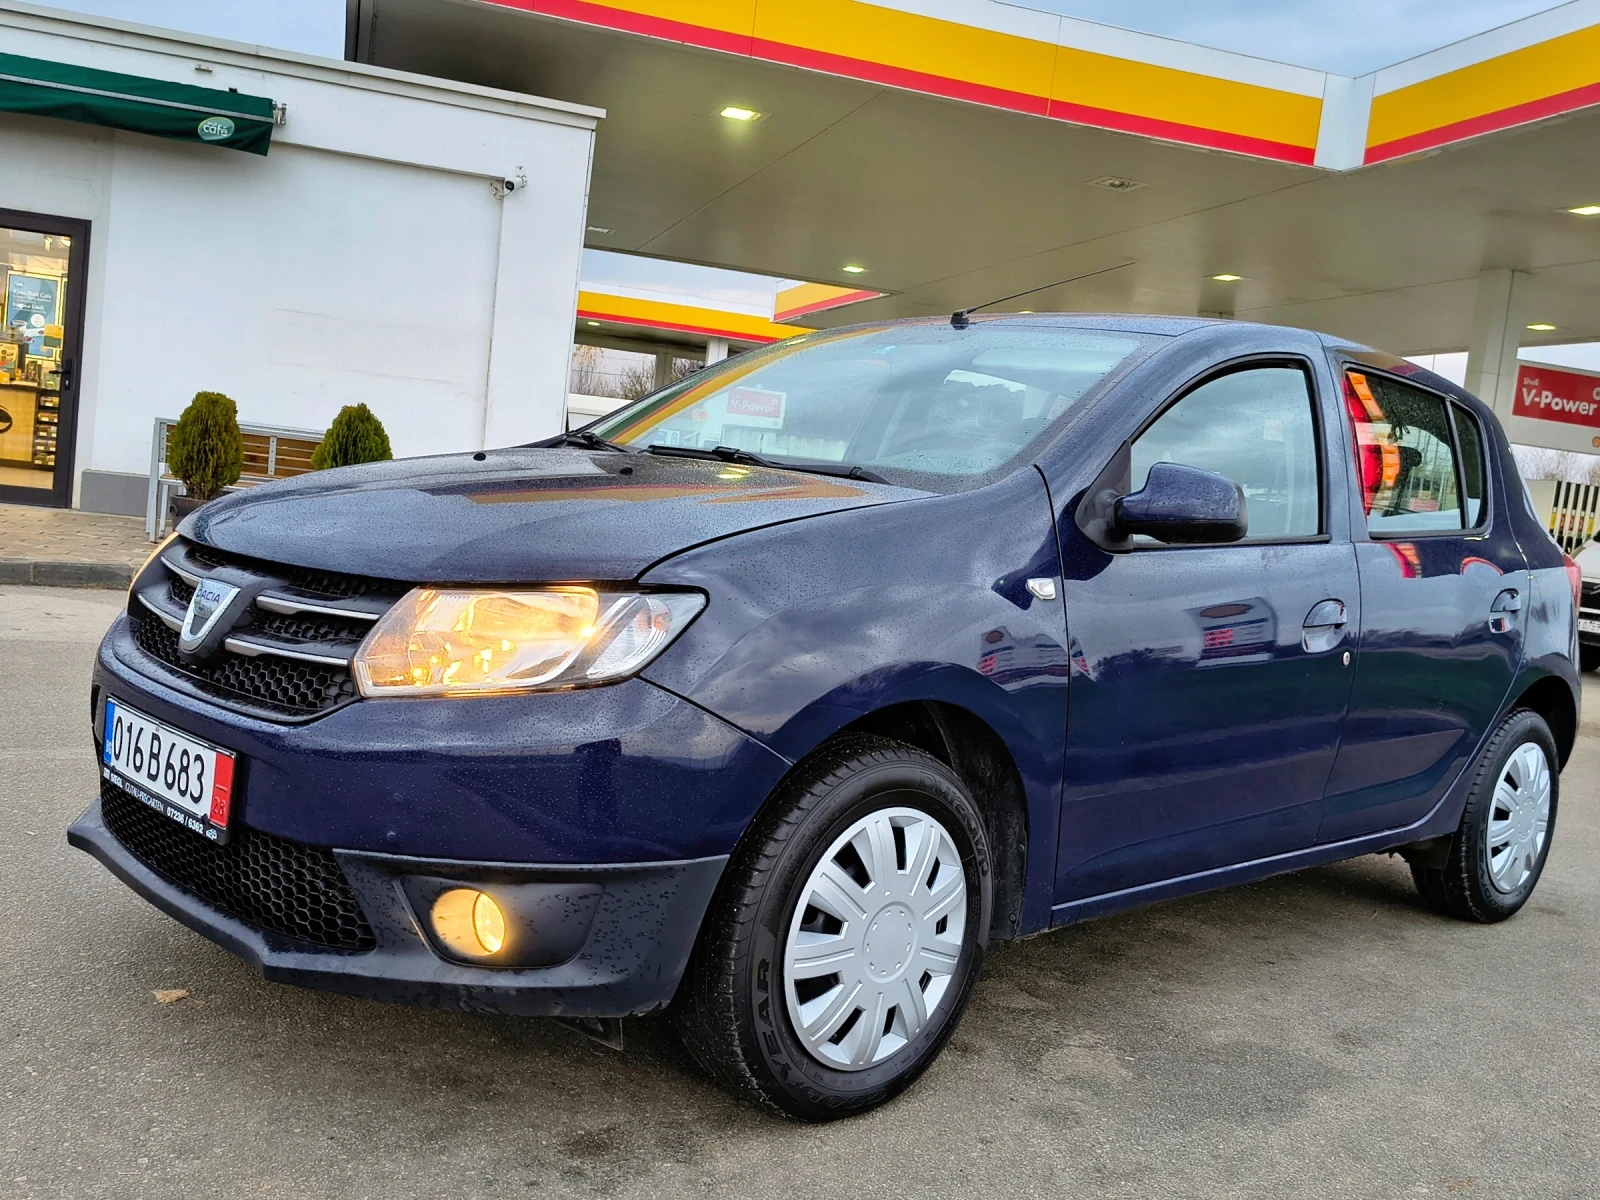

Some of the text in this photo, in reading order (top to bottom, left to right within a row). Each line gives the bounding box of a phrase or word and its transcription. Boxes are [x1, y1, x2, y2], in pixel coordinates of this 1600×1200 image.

[203, 124, 228, 137] café
[1523, 378, 1539, 386] Shell
[731, 399, 776, 413] V-Power
[1521, 387, 1597, 416] V-Power
[196, 588, 220, 604] DACIA
[113, 715, 205, 804] 016B683
